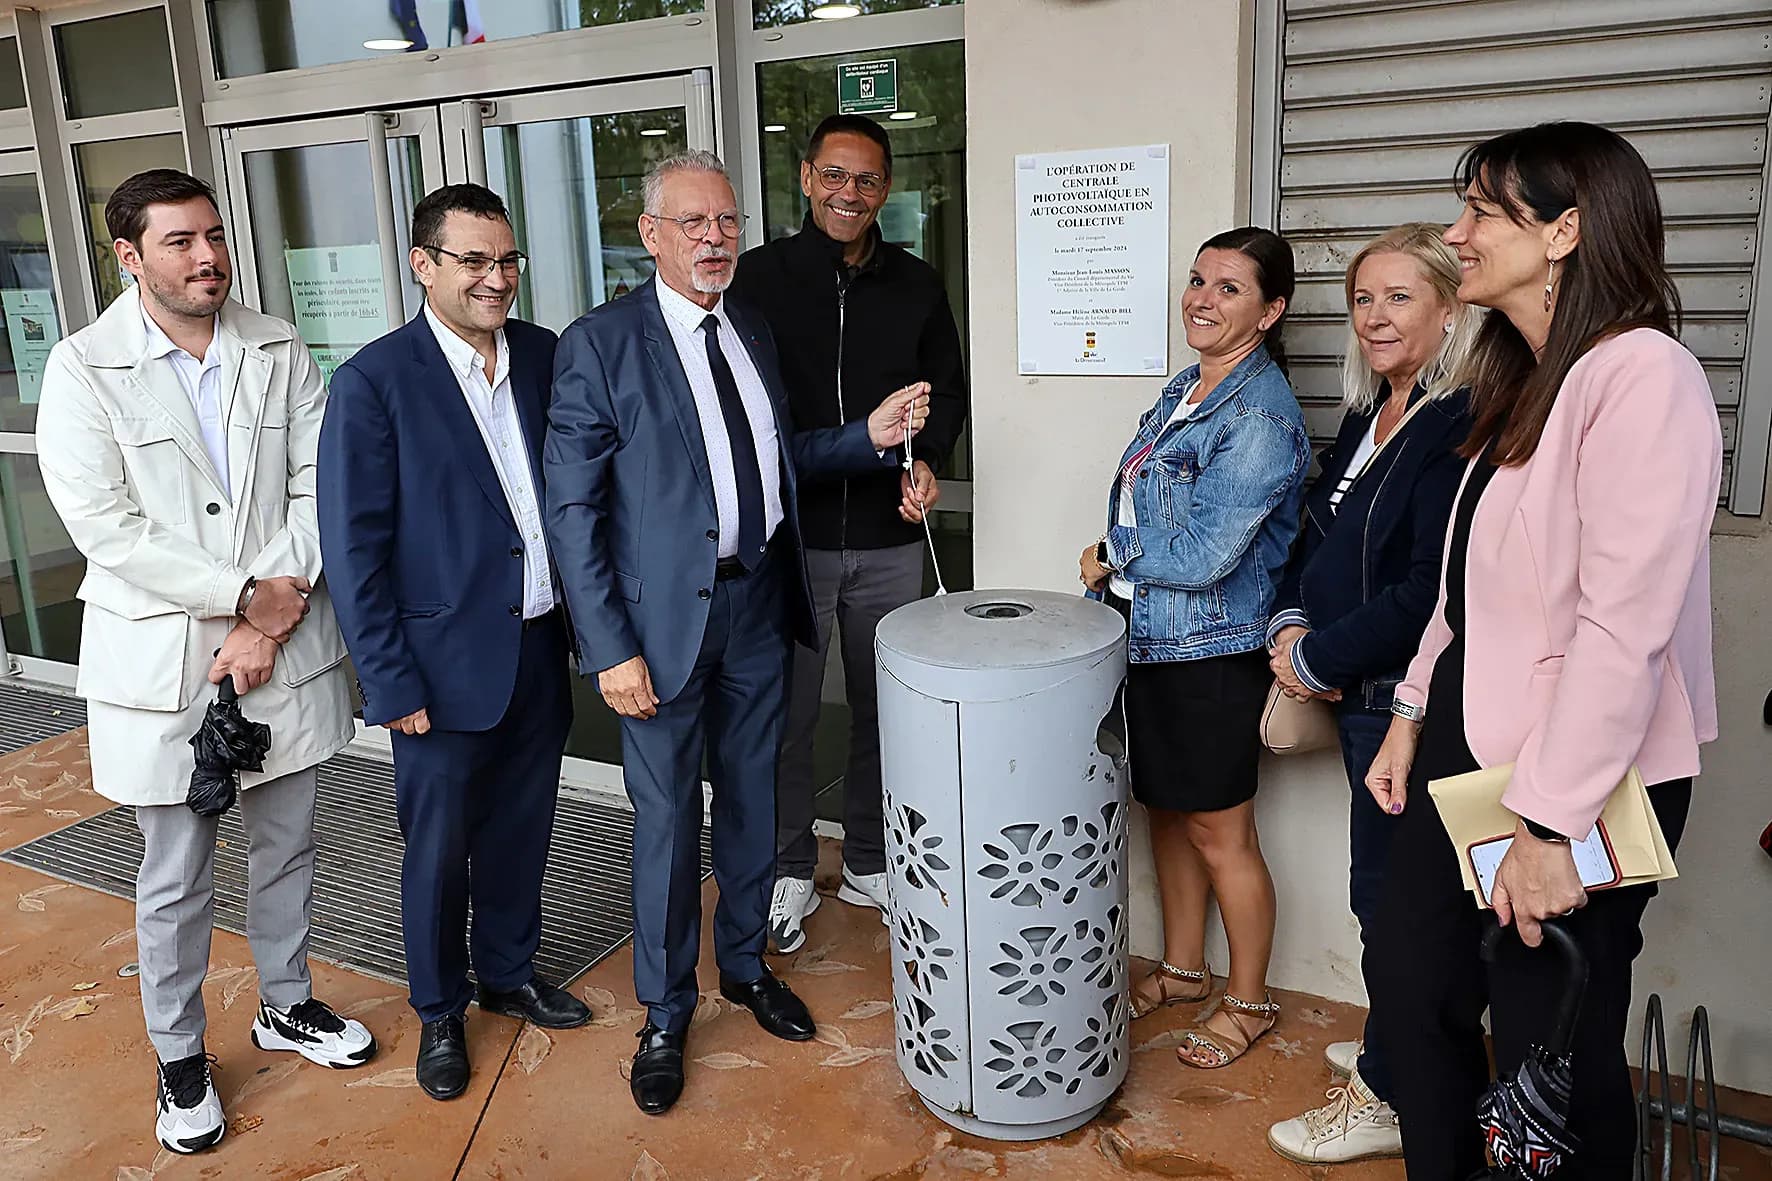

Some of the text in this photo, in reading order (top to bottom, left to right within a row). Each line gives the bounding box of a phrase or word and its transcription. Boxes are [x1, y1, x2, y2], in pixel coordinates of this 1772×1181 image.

[1047, 162, 1135, 176] L'OPÉRATION DE
[1062, 176, 1119, 188] CENTRALE
[1034, 187, 1150, 203] PHOTOVOLTAÏQUE EN
[1030, 201, 1153, 216] AUTOCONSOMMATION
[1057, 216, 1124, 228] COLLECTIVE
